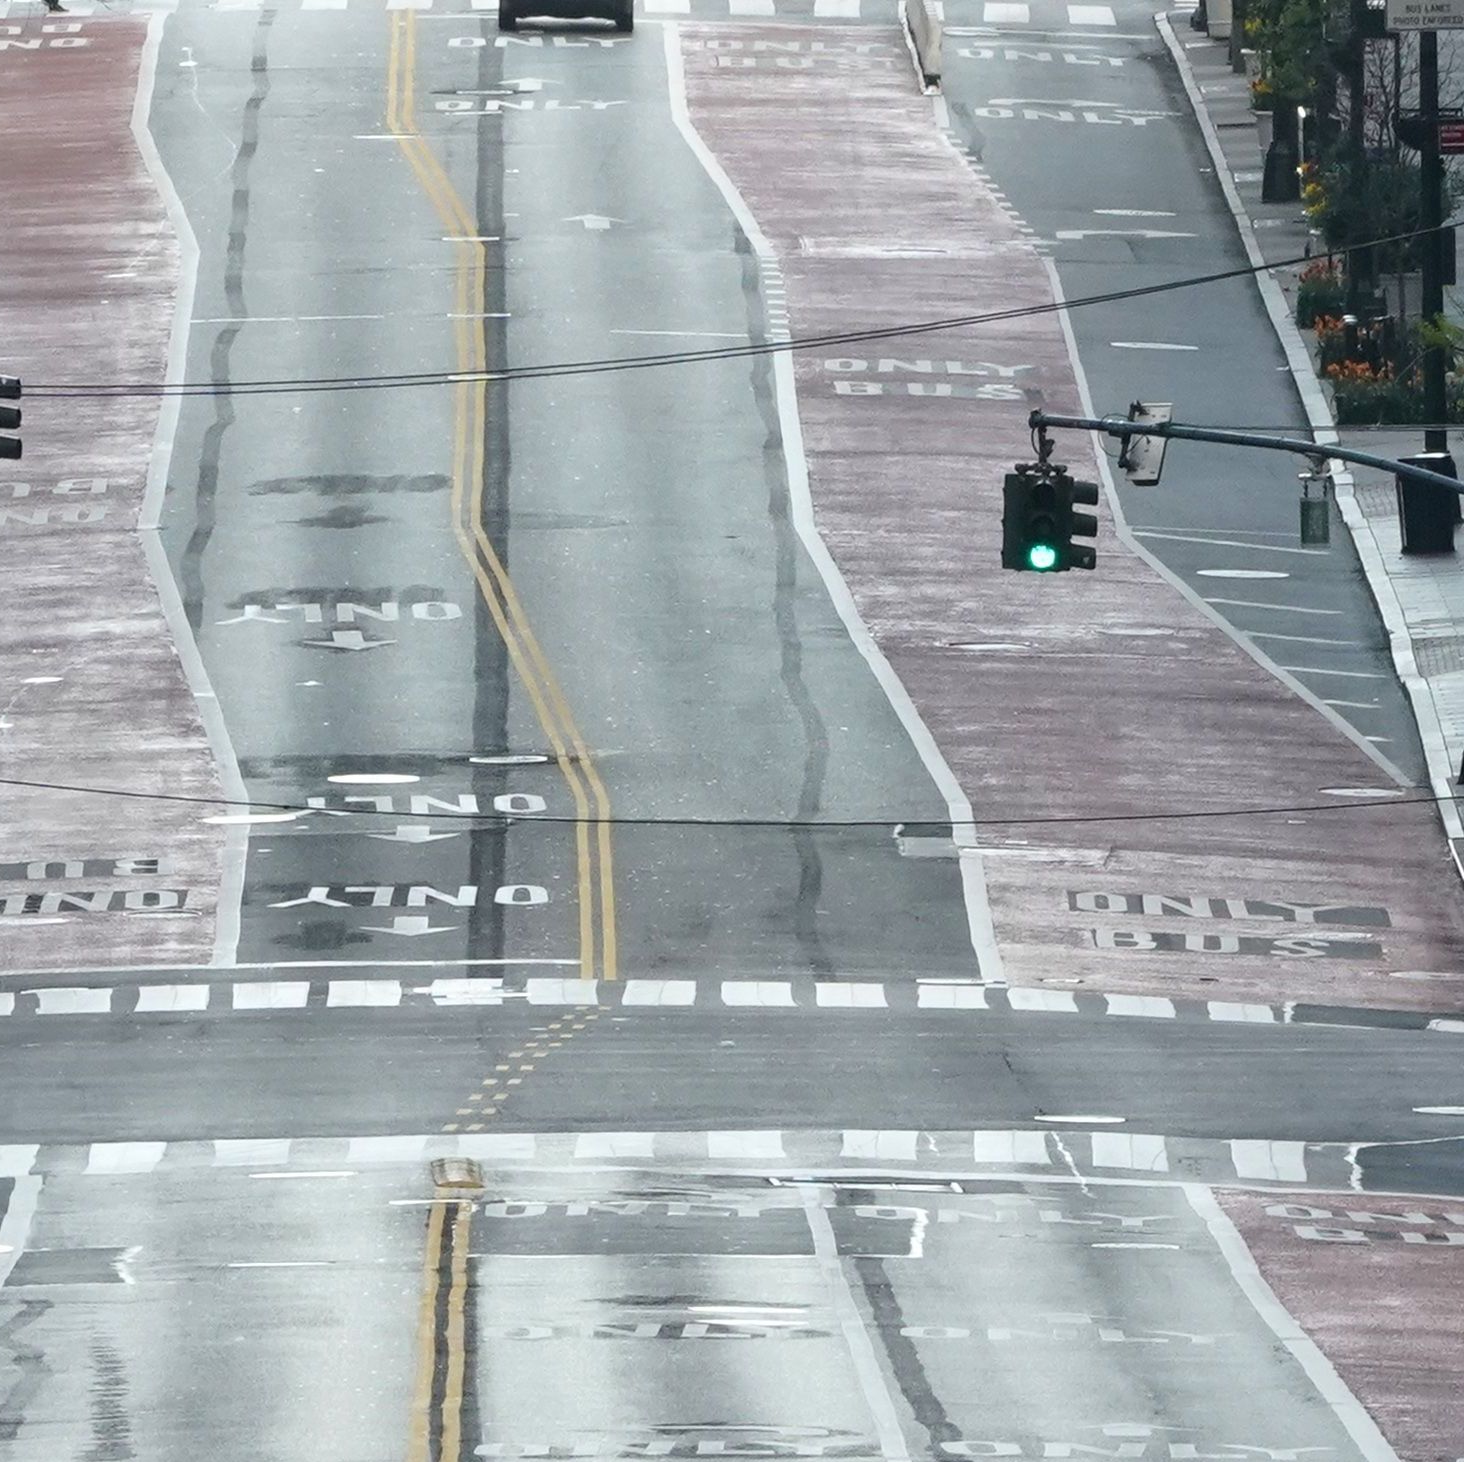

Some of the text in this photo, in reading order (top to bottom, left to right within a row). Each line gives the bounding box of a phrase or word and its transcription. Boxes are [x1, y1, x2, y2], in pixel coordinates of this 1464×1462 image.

[447, 37, 631, 48] ONLY
[957, 47, 1138, 66] ONLY
[436, 100, 630, 112] ONLY
[974, 107, 1164, 125] ONLY
[824, 358, 1034, 377] ONLY
[834, 380, 1026, 400] BUS
[215, 602, 464, 625] ONLY
[279, 793, 548, 818] ONLY
[267, 885, 550, 909] ONLY
[1075, 891, 1344, 923] ONLY
[1094, 928, 1330, 959] BUS
